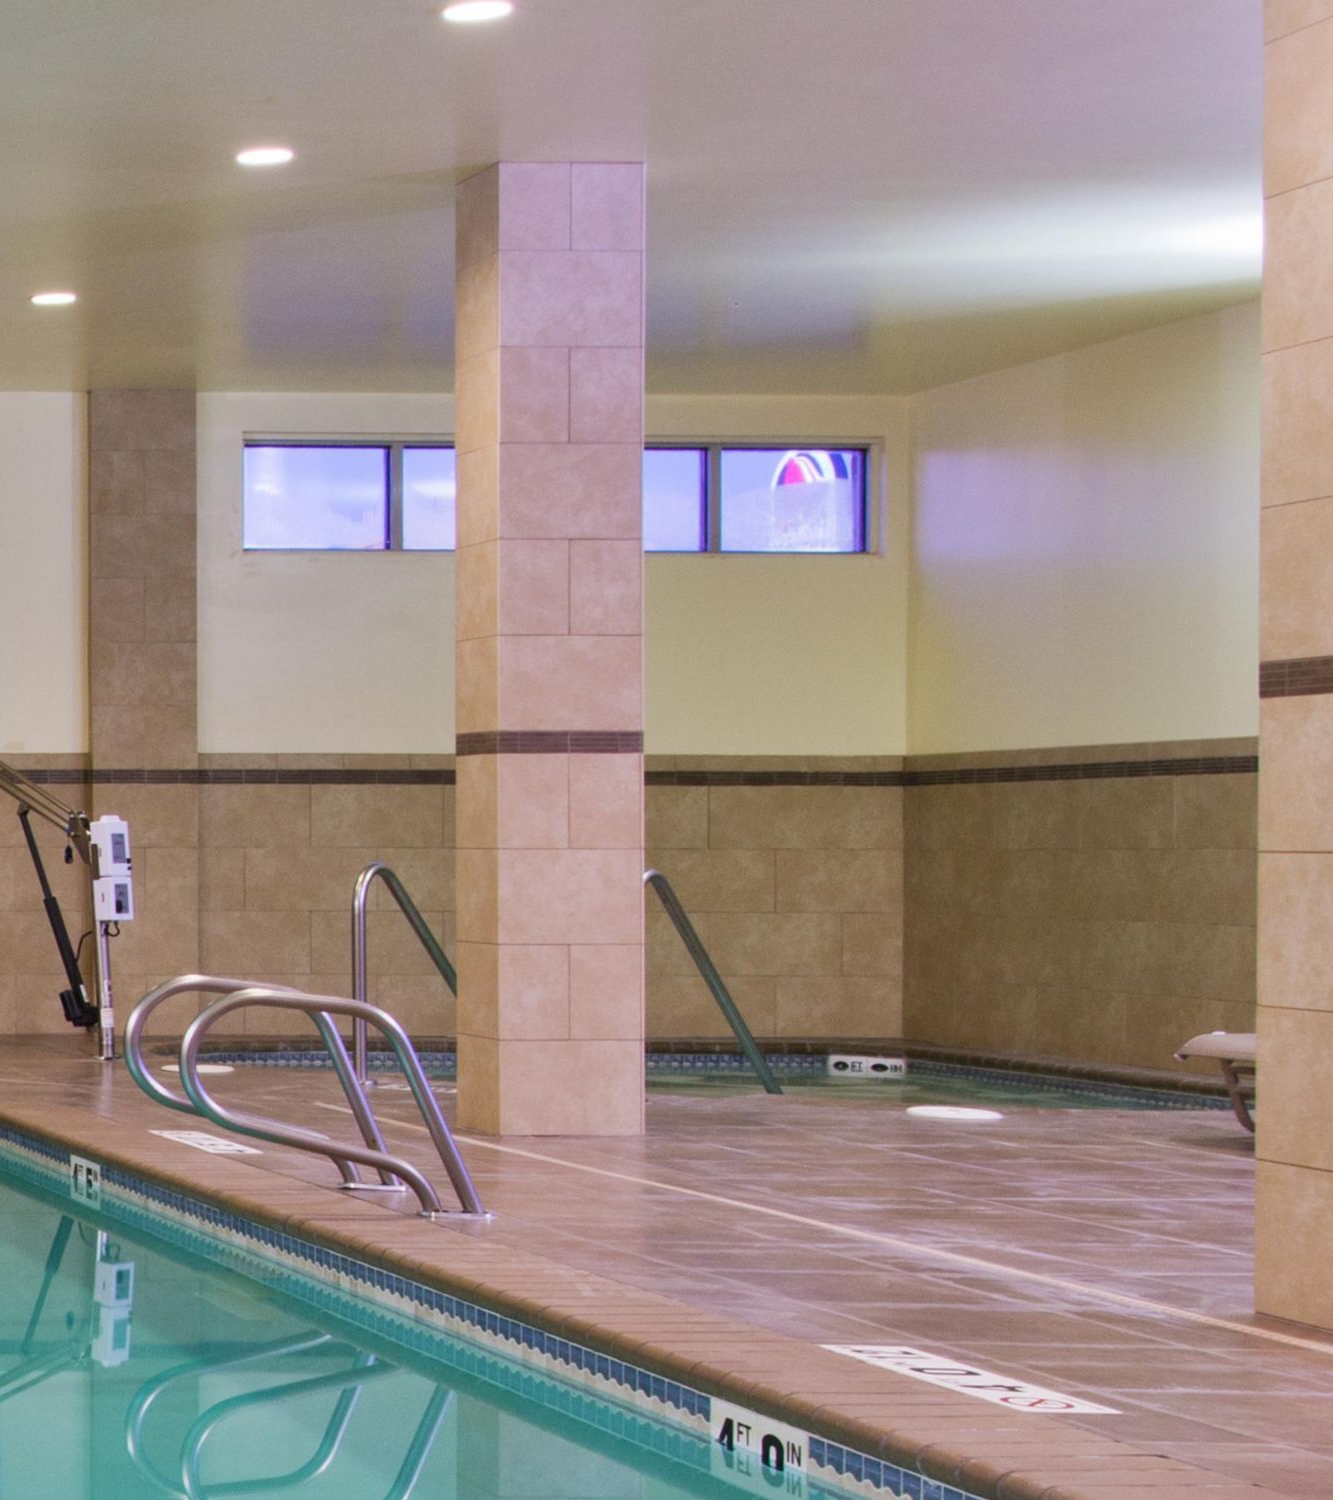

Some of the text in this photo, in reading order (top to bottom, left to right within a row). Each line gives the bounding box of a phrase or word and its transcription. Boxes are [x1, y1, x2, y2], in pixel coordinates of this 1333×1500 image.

[715, 1417, 734, 1451] 4
[736, 1422, 752, 1446] FT
[786, 1440, 802, 1467] IN
